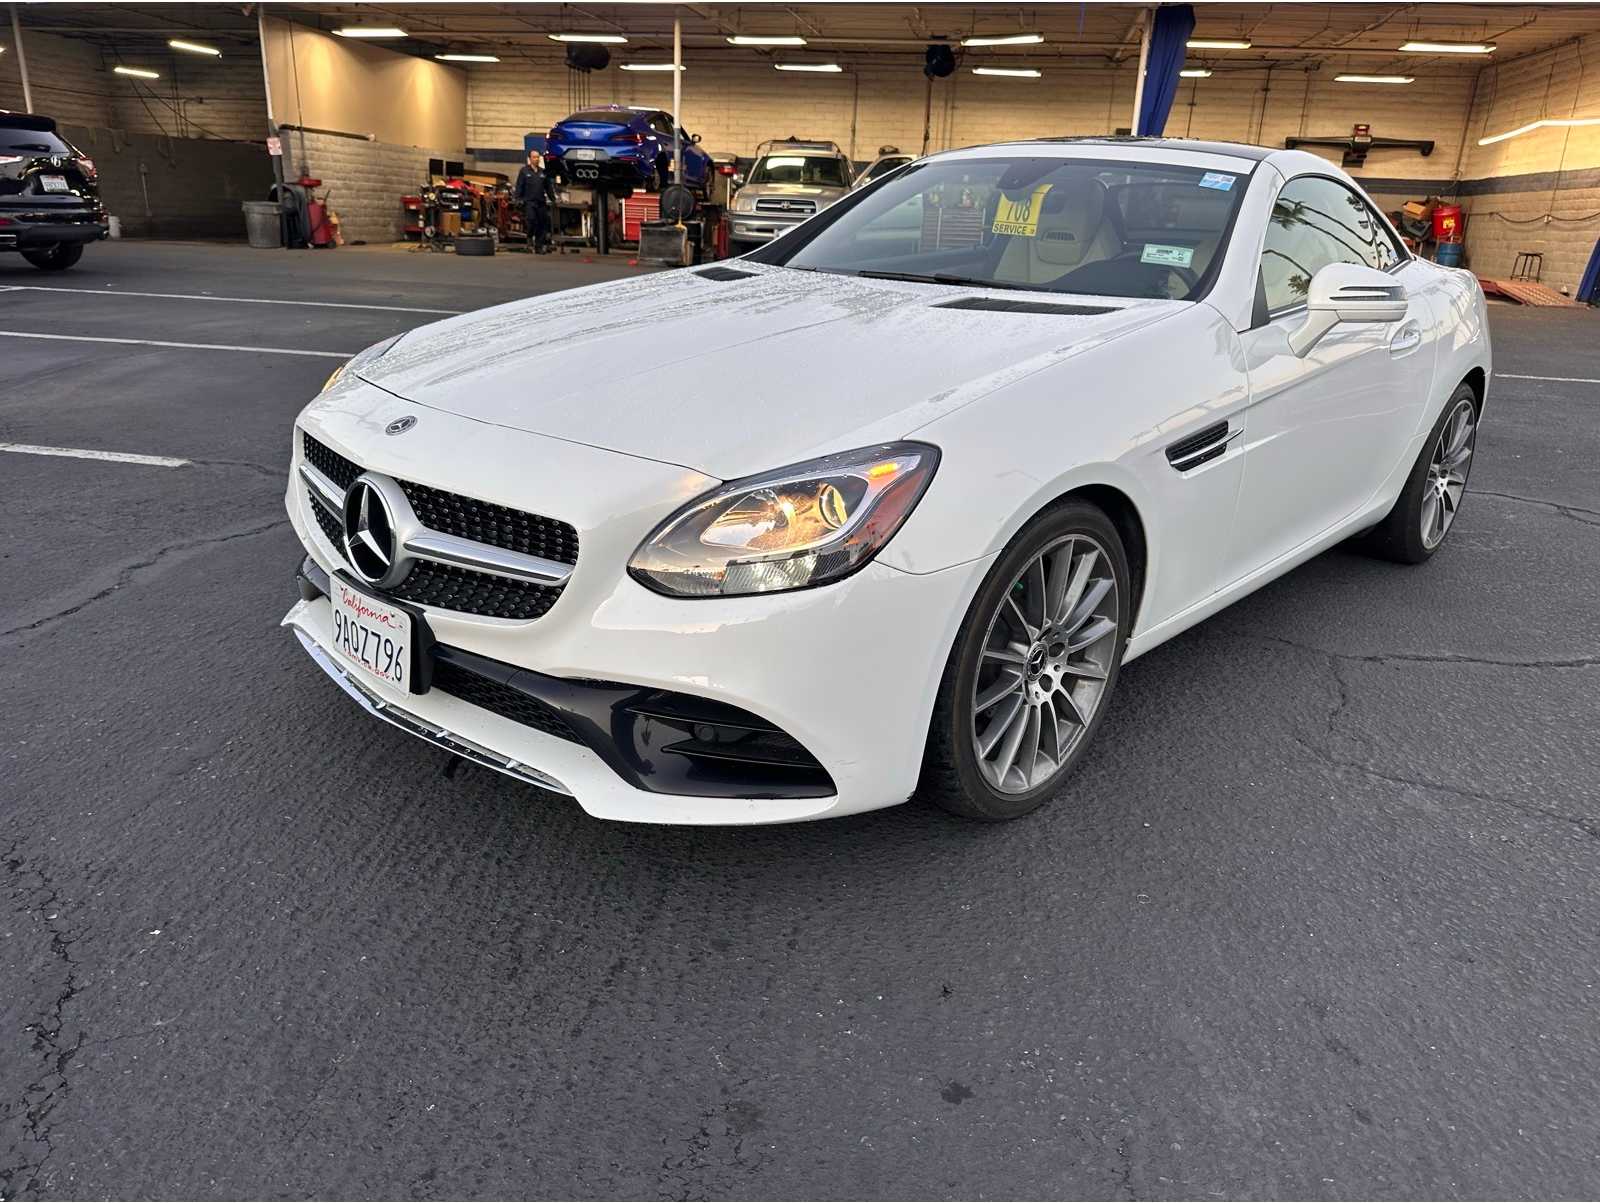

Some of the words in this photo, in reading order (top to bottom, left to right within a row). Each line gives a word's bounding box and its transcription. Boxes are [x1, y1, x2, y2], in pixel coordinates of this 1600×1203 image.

[993, 224, 1027, 234] SERVICE
[342, 587, 396, 628] California
[335, 609, 403, 681] 9AQZ796
